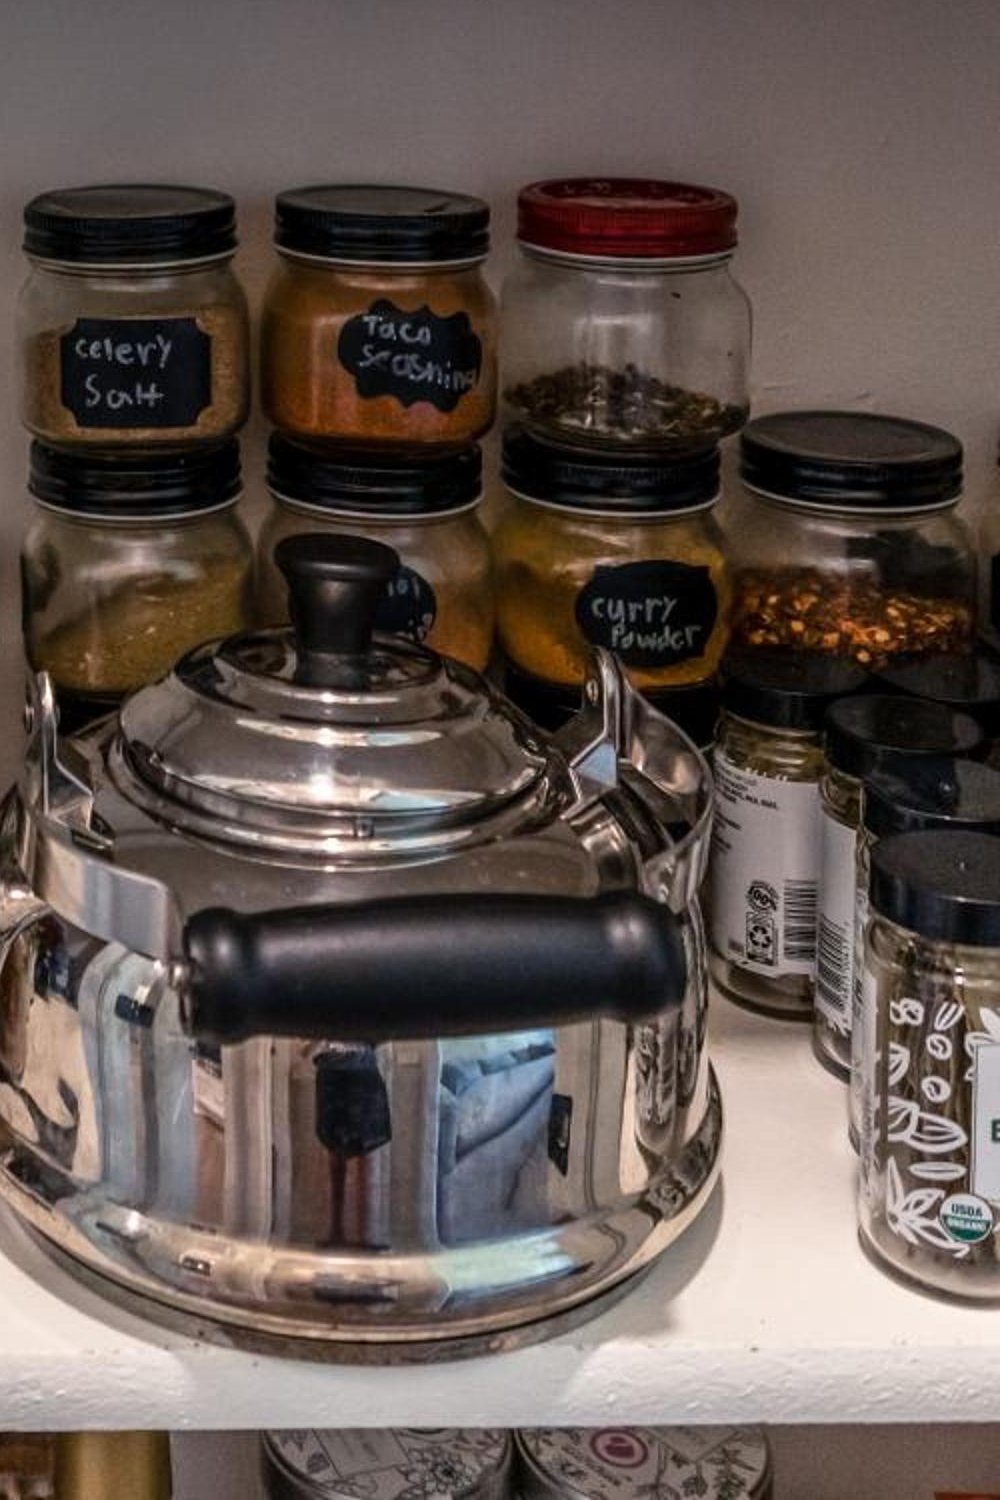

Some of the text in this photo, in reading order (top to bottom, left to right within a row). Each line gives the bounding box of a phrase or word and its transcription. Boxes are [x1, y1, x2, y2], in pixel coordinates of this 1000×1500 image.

[361, 315, 432, 347] Taco
[85, 373, 165, 409] Salt
[951, 1203, 983, 1218] USDA
